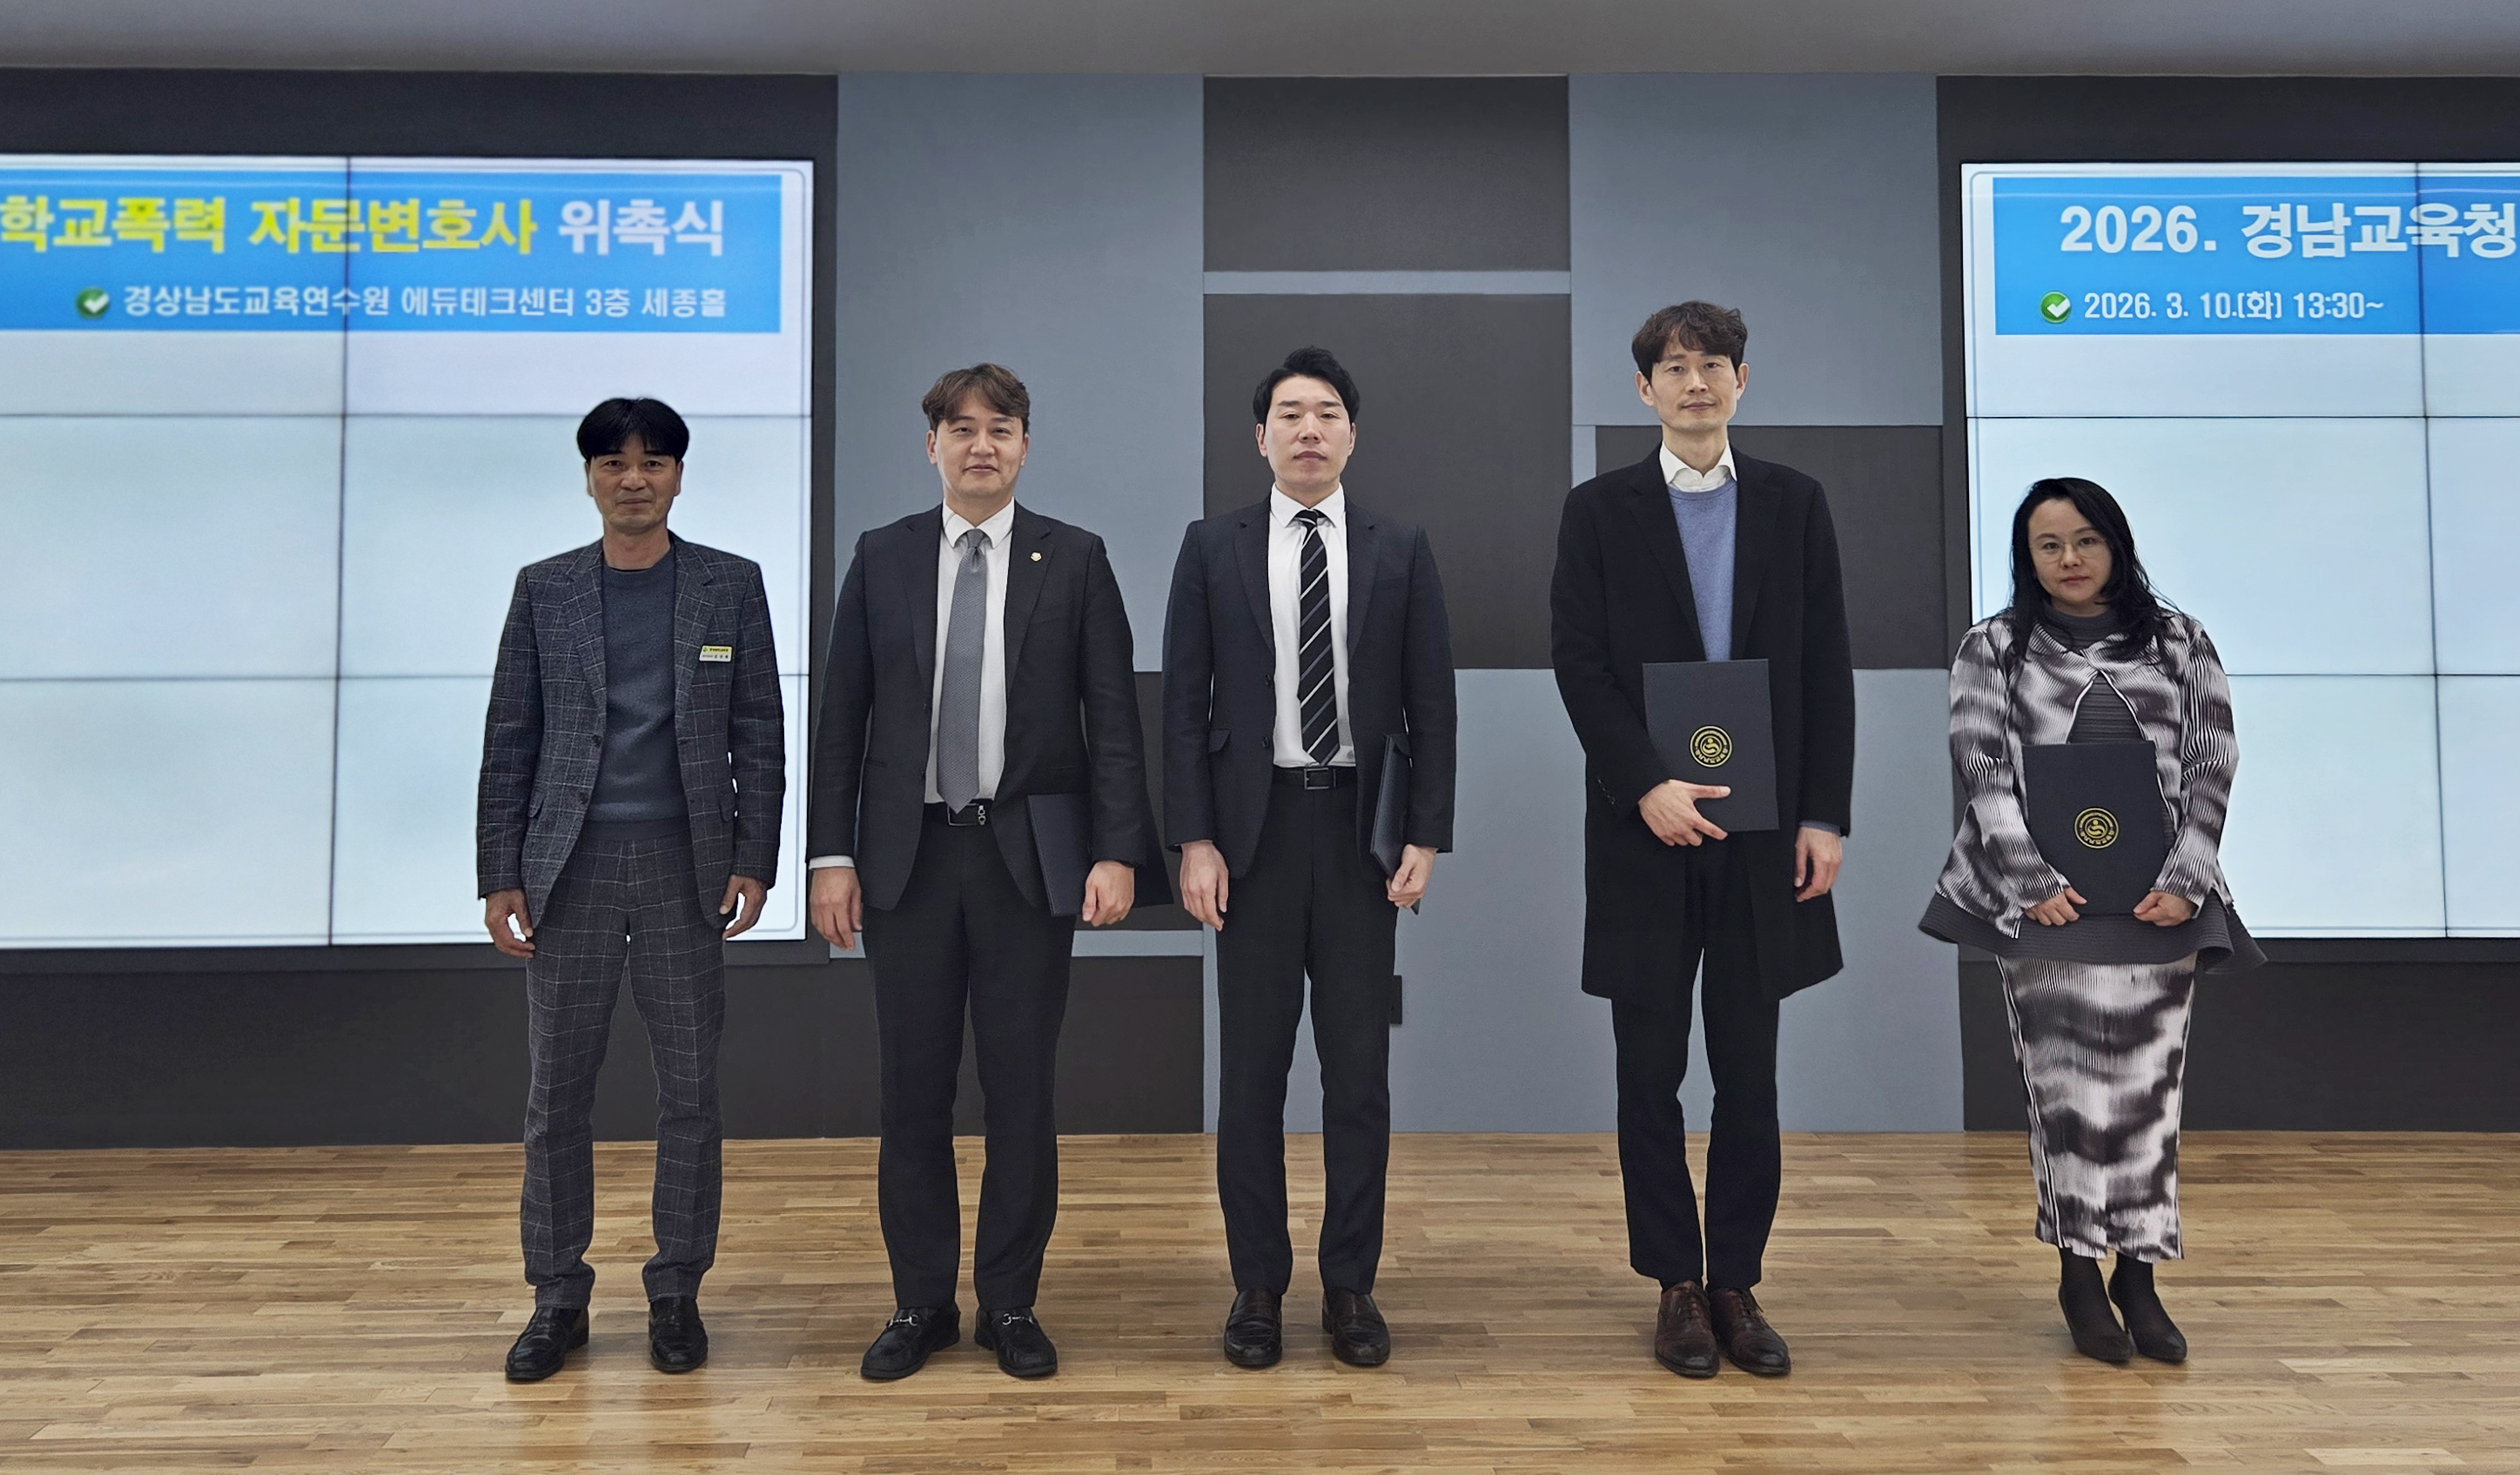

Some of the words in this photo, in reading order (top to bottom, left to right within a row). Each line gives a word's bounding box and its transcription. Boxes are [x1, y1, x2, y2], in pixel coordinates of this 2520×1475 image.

[0, 196, 225, 253] 학교폭력
[247, 197, 538, 255] 자문변호사
[558, 198, 724, 256] 위촉식
[2060, 204, 2217, 253] 2026.
[2241, 202, 2517, 259] 경남교육청
[124, 285, 390, 317] 경상남도교육연수원
[401, 286, 575, 318] 에듀테크센터
[586, 288, 631, 318] 3층
[642, 288, 727, 318] 세종홀
[2084, 292, 2156, 319] 2026.
[2166, 292, 2189, 319] 3.
[2293, 292, 2385, 319] 13:30~
